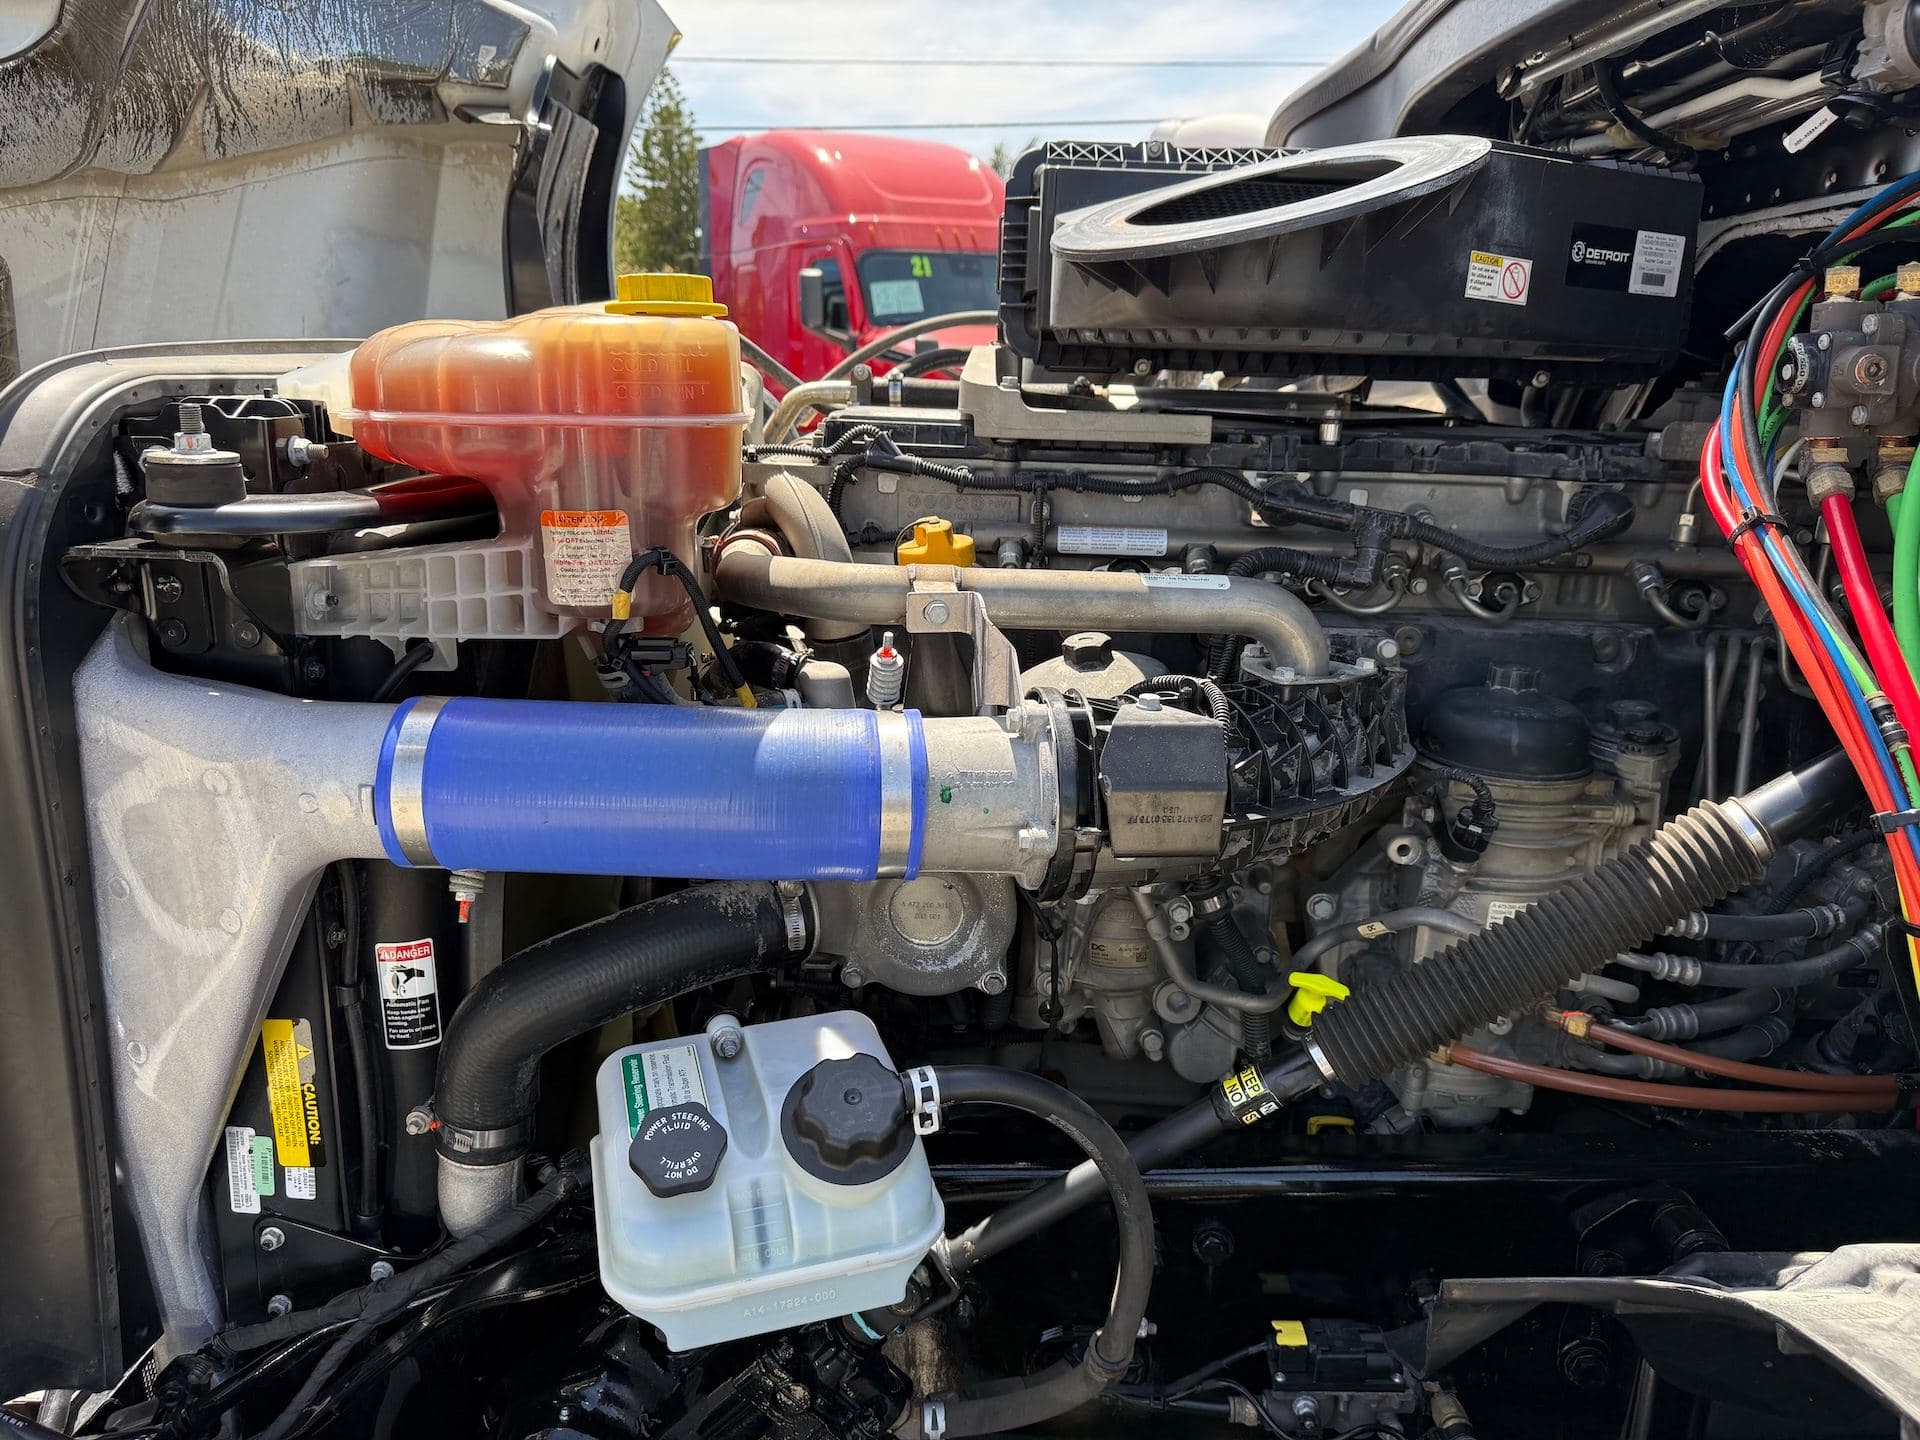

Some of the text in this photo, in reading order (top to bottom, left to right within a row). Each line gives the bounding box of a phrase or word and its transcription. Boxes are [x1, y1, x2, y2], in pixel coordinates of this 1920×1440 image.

[1475, 254, 1499, 265] CAUTION
[1586, 248, 1631, 263] DETROIT
[910, 255, 933, 278] 21
[1367, 924, 1377, 932] DC
[390, 945, 431, 960] DANGER
[1091, 943, 1105, 951] DC
[630, 1058, 641, 1085] Reservoir
[634, 1083, 644, 1109] Steering
[1226, 1083, 1242, 1102] NO
[303, 1083, 320, 1145] CAUTION:
[644, 1112, 711, 1141] POWER STEERING
[662, 1121, 691, 1134] FLUID
[660, 1151, 701, 1170] OVERFILL
[664, 1165, 699, 1179] DO NOT
